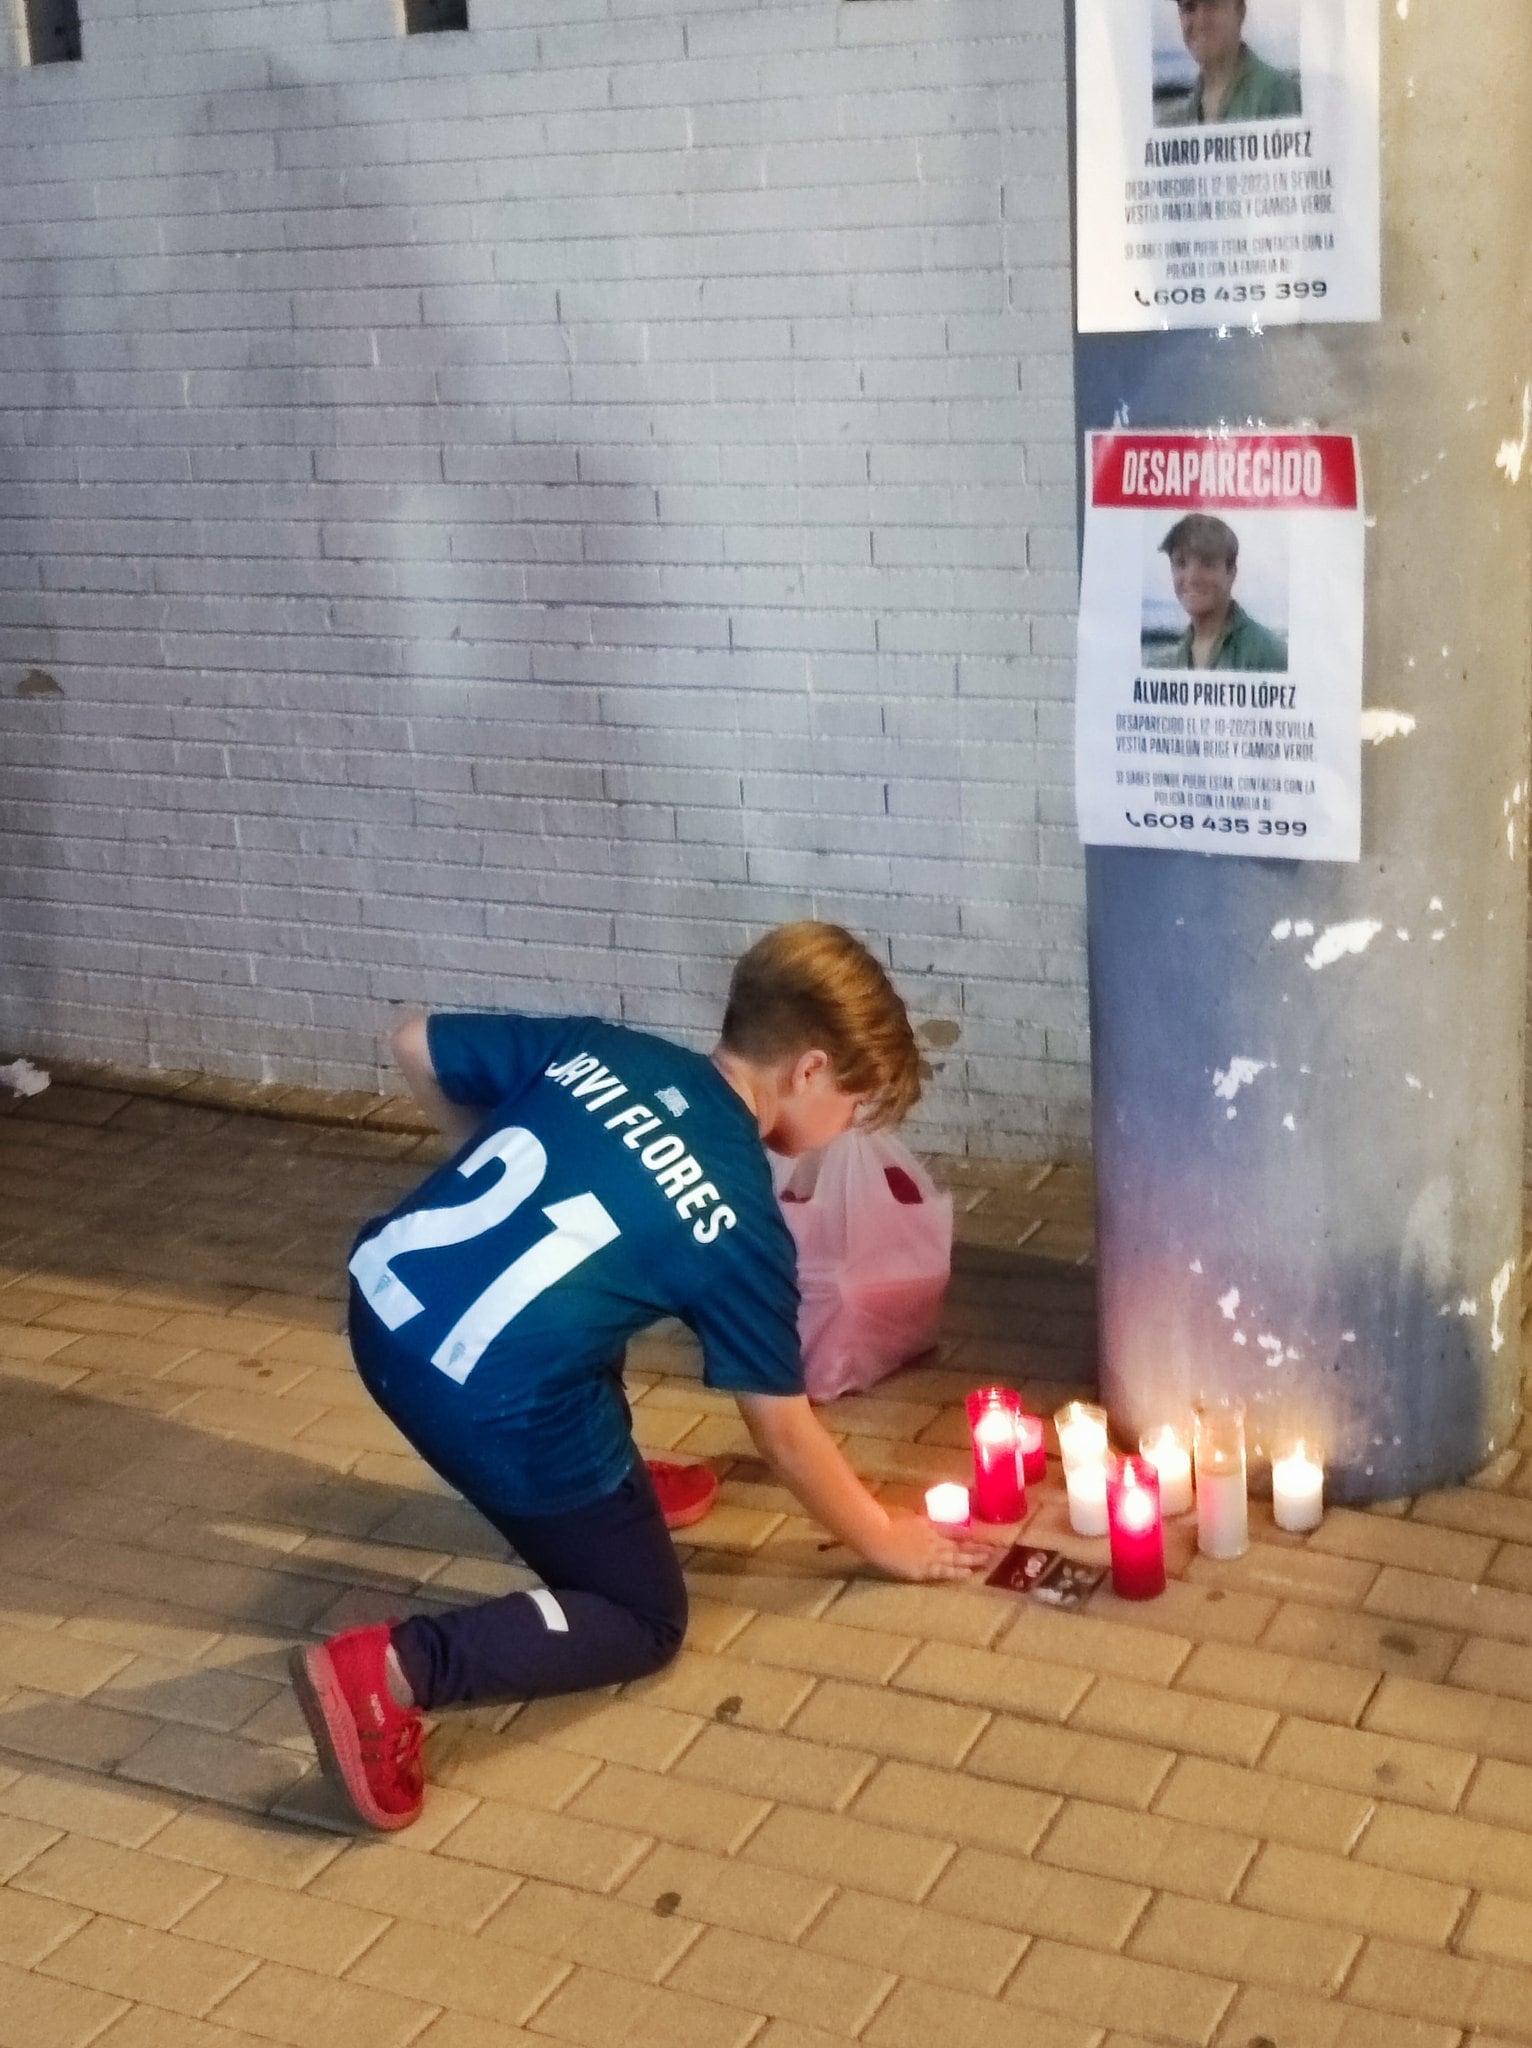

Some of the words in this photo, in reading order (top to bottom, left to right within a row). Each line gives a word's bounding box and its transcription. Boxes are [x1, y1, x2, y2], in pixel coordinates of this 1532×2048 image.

[1145, 138, 1199, 167] ÁLVARO
[1204, 135, 1258, 162] PRIETO
[1264, 129, 1312, 160] LÓPEZ
[1154, 287, 1206, 306] 608
[1214, 284, 1266, 302] 435
[1275, 280, 1328, 300] 399
[1122, 448, 1322, 498] DESAPARECIDO
[1133, 677, 1188, 705] ÁLVARO
[1194, 682, 1246, 708] PRIETO
[1251, 682, 1296, 709] LÓPEZ
[1116, 713, 1184, 734] DESAPARECIDO
[1144, 813, 1194, 830] 608
[1202, 816, 1249, 834] 435
[1258, 819, 1307, 837] 399
[545, 1052, 629, 1112] JAVI
[603, 1104, 737, 1244] FLORES
[349, 1125, 621, 1385] 21
